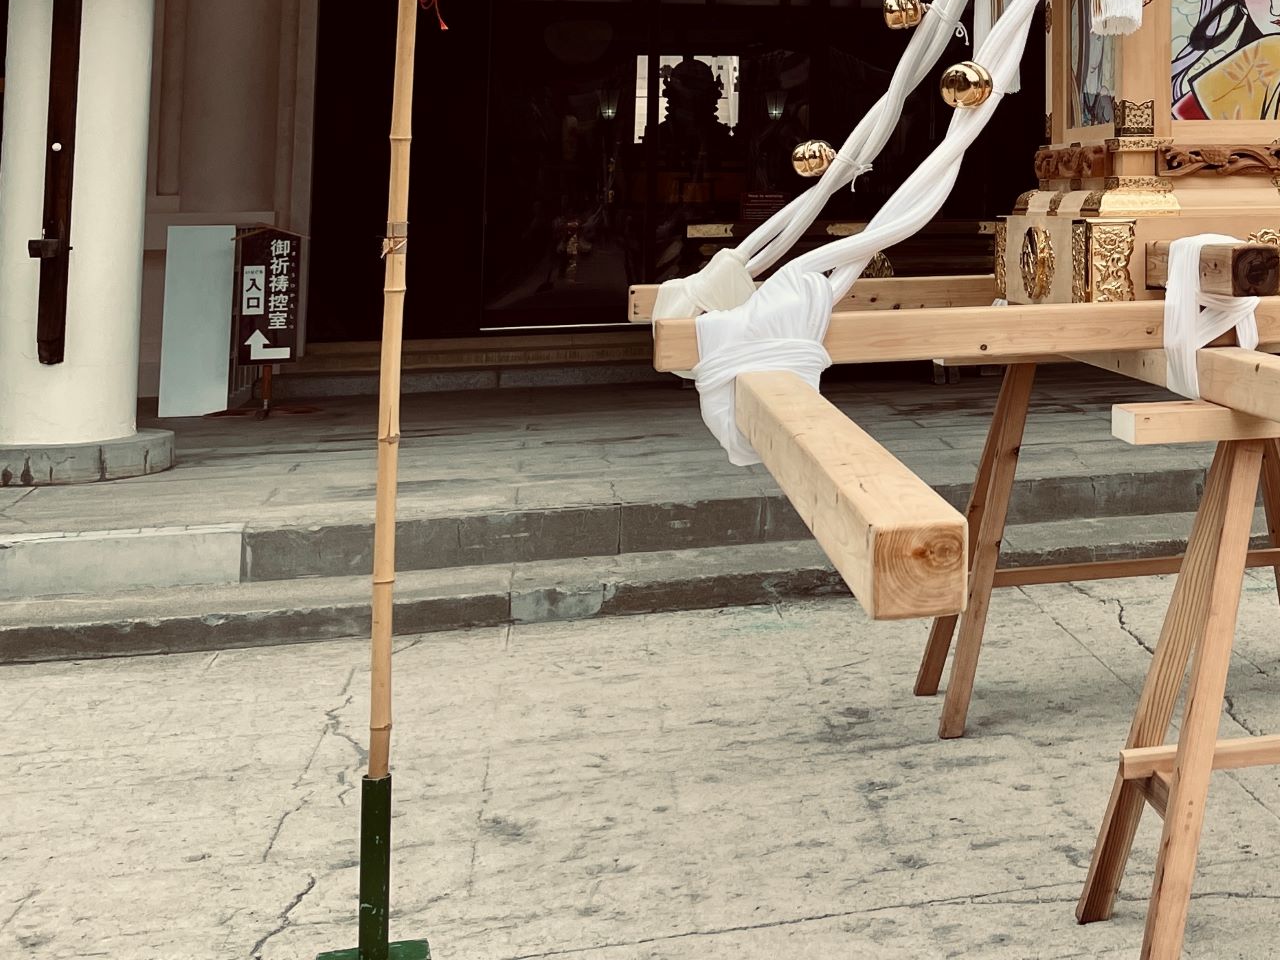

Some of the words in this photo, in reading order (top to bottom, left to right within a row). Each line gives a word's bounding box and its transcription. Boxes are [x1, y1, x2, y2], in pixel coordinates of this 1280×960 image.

[246, 278, 261, 309] 入口
[268, 239, 290, 329] 御祈祷控室
